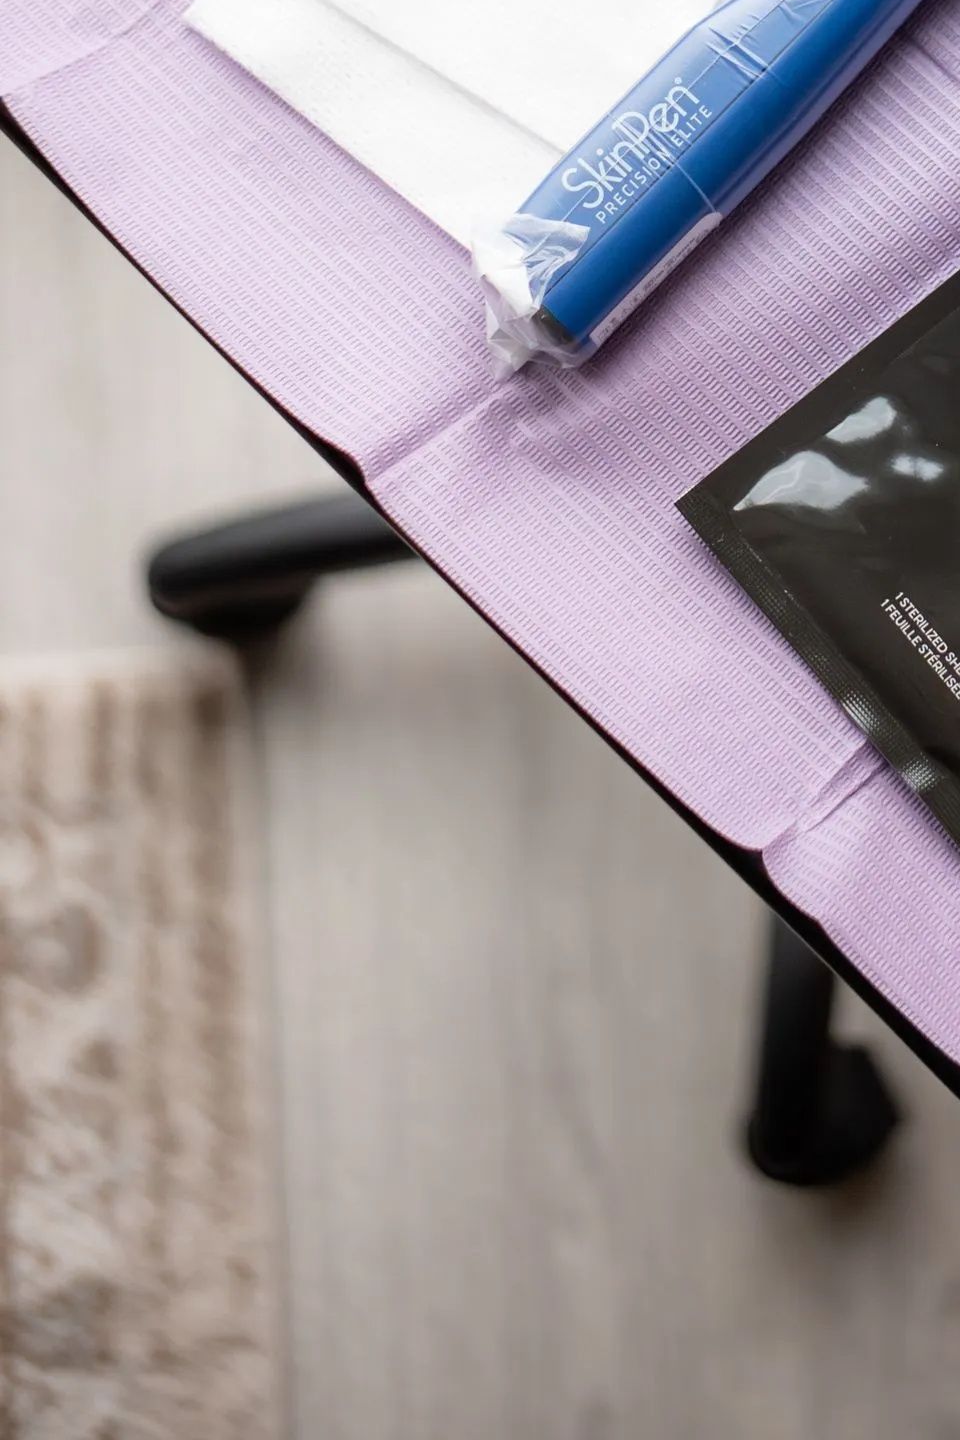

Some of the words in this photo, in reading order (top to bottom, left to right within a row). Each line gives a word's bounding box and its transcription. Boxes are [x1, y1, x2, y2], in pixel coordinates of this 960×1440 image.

[561, 85, 700, 209] SkinPen
[595, 150, 673, 224] PRECISION
[670, 104, 713, 148] ELITE
[880, 598, 890, 607] 1
[885, 604, 922, 647] FEUILLE
[895, 592, 903, 600] 1
[899, 597, 948, 654] STERILIZED
